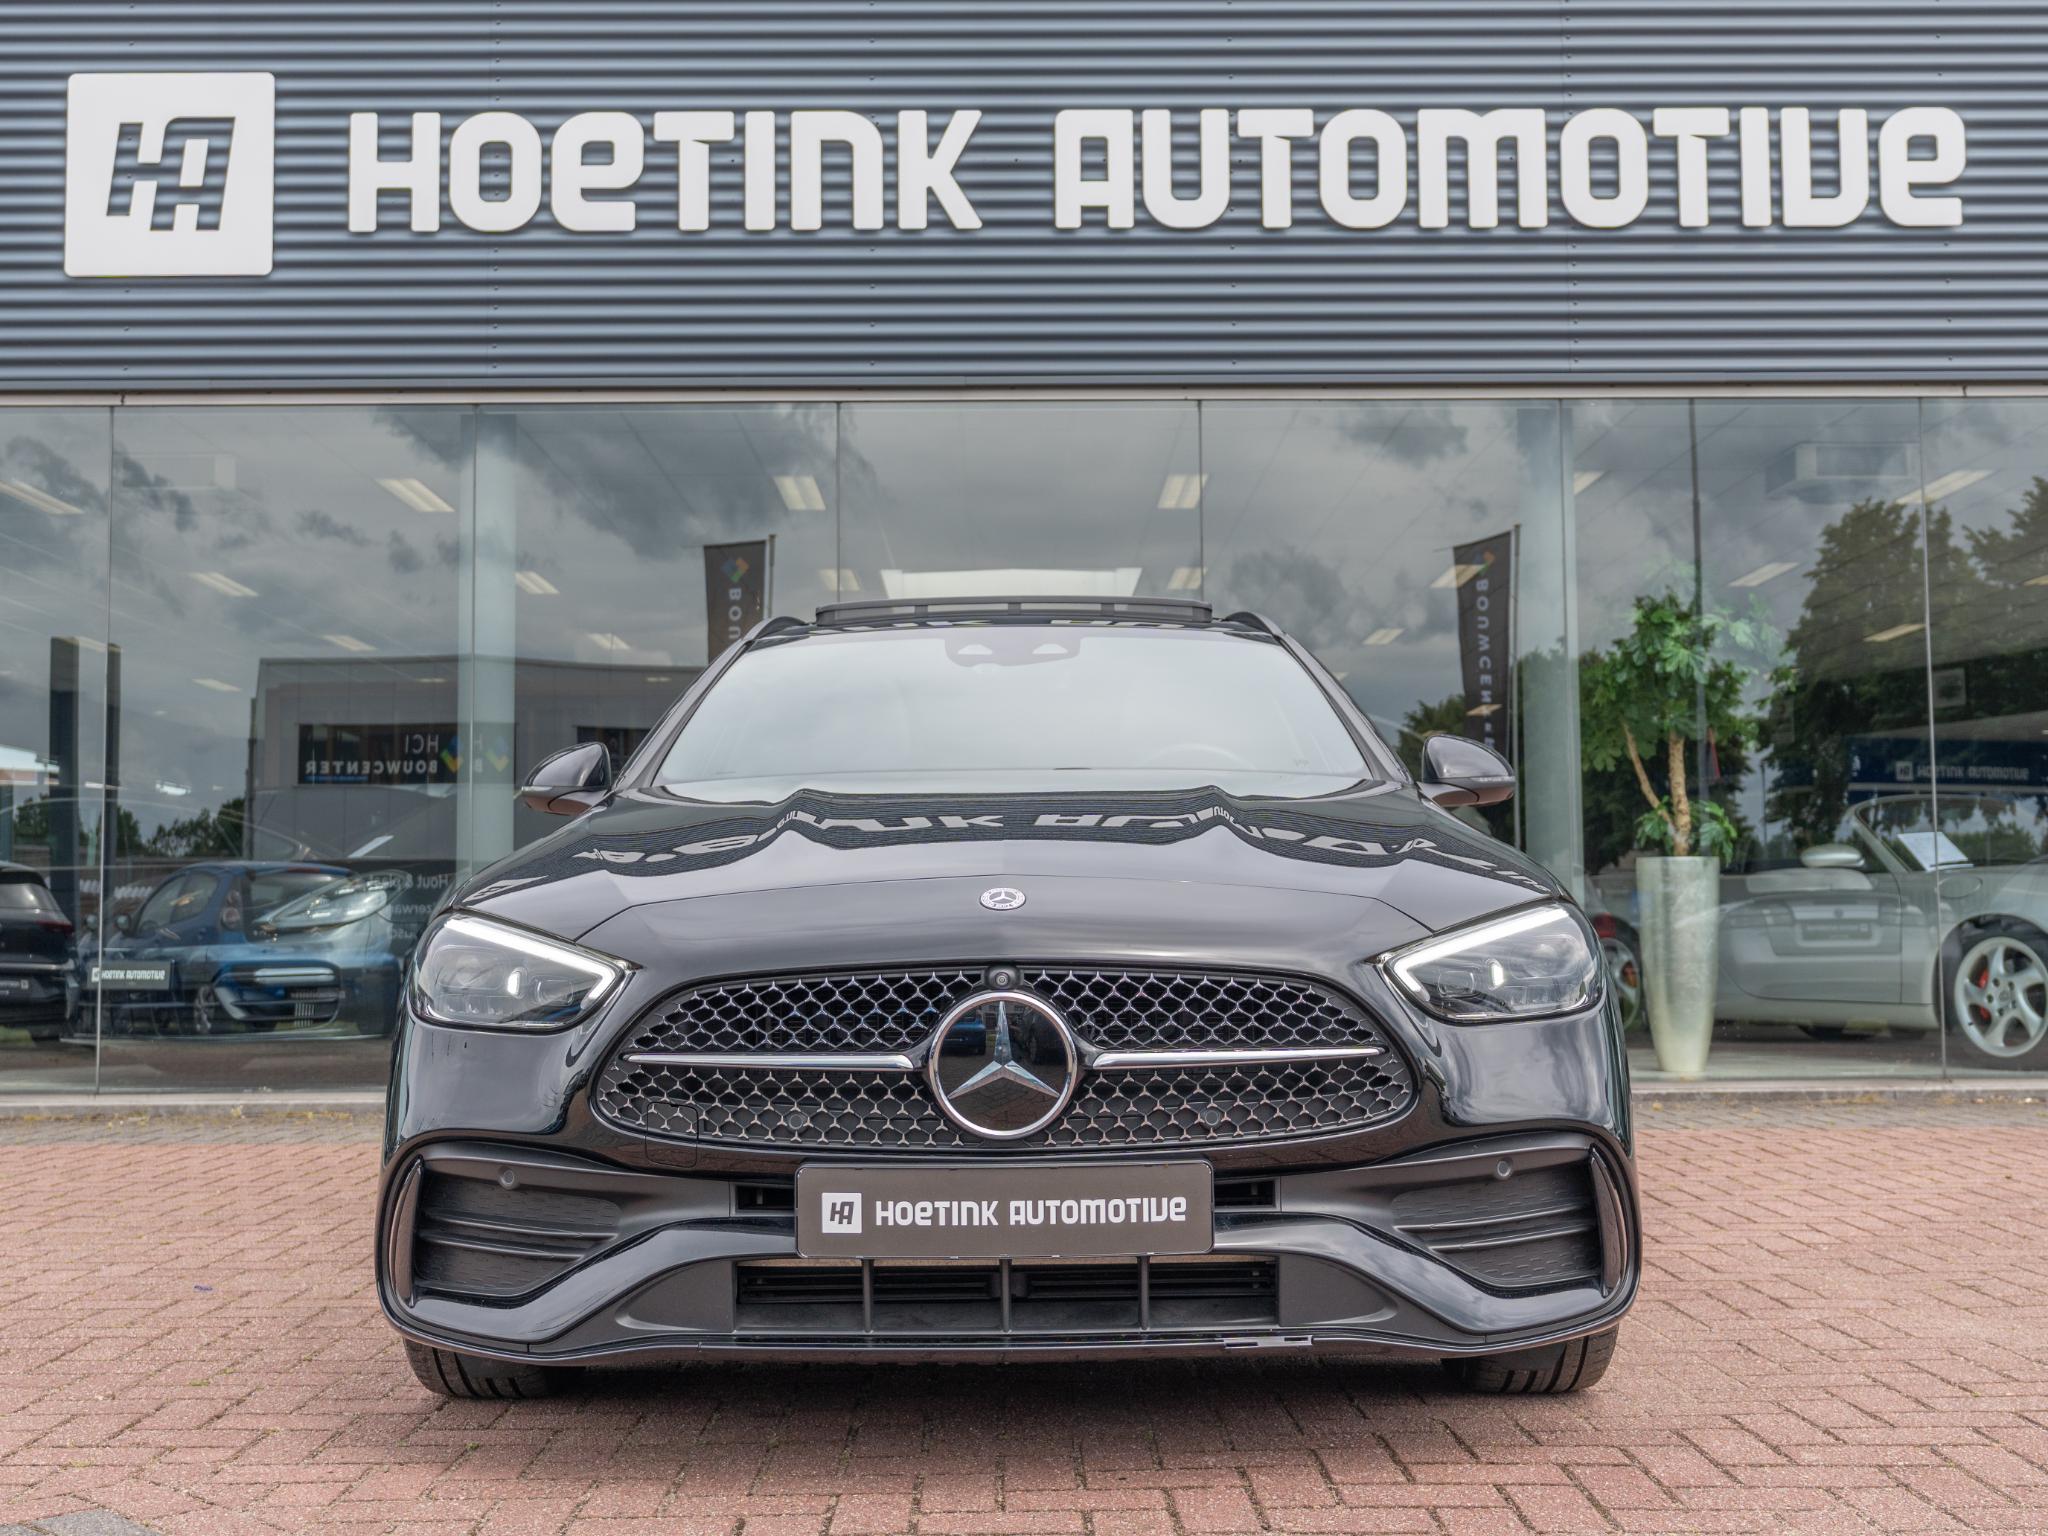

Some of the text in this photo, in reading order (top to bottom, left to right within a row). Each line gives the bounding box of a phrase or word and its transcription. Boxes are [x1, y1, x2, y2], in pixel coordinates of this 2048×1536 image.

[348, 109, 983, 233] HOETINK
[1053, 106, 1967, 230] AUTOMOTIVE
[875, 1200, 999, 1227] HOETINK
[1009, 1196, 1188, 1226] AUTOMOTIVE
